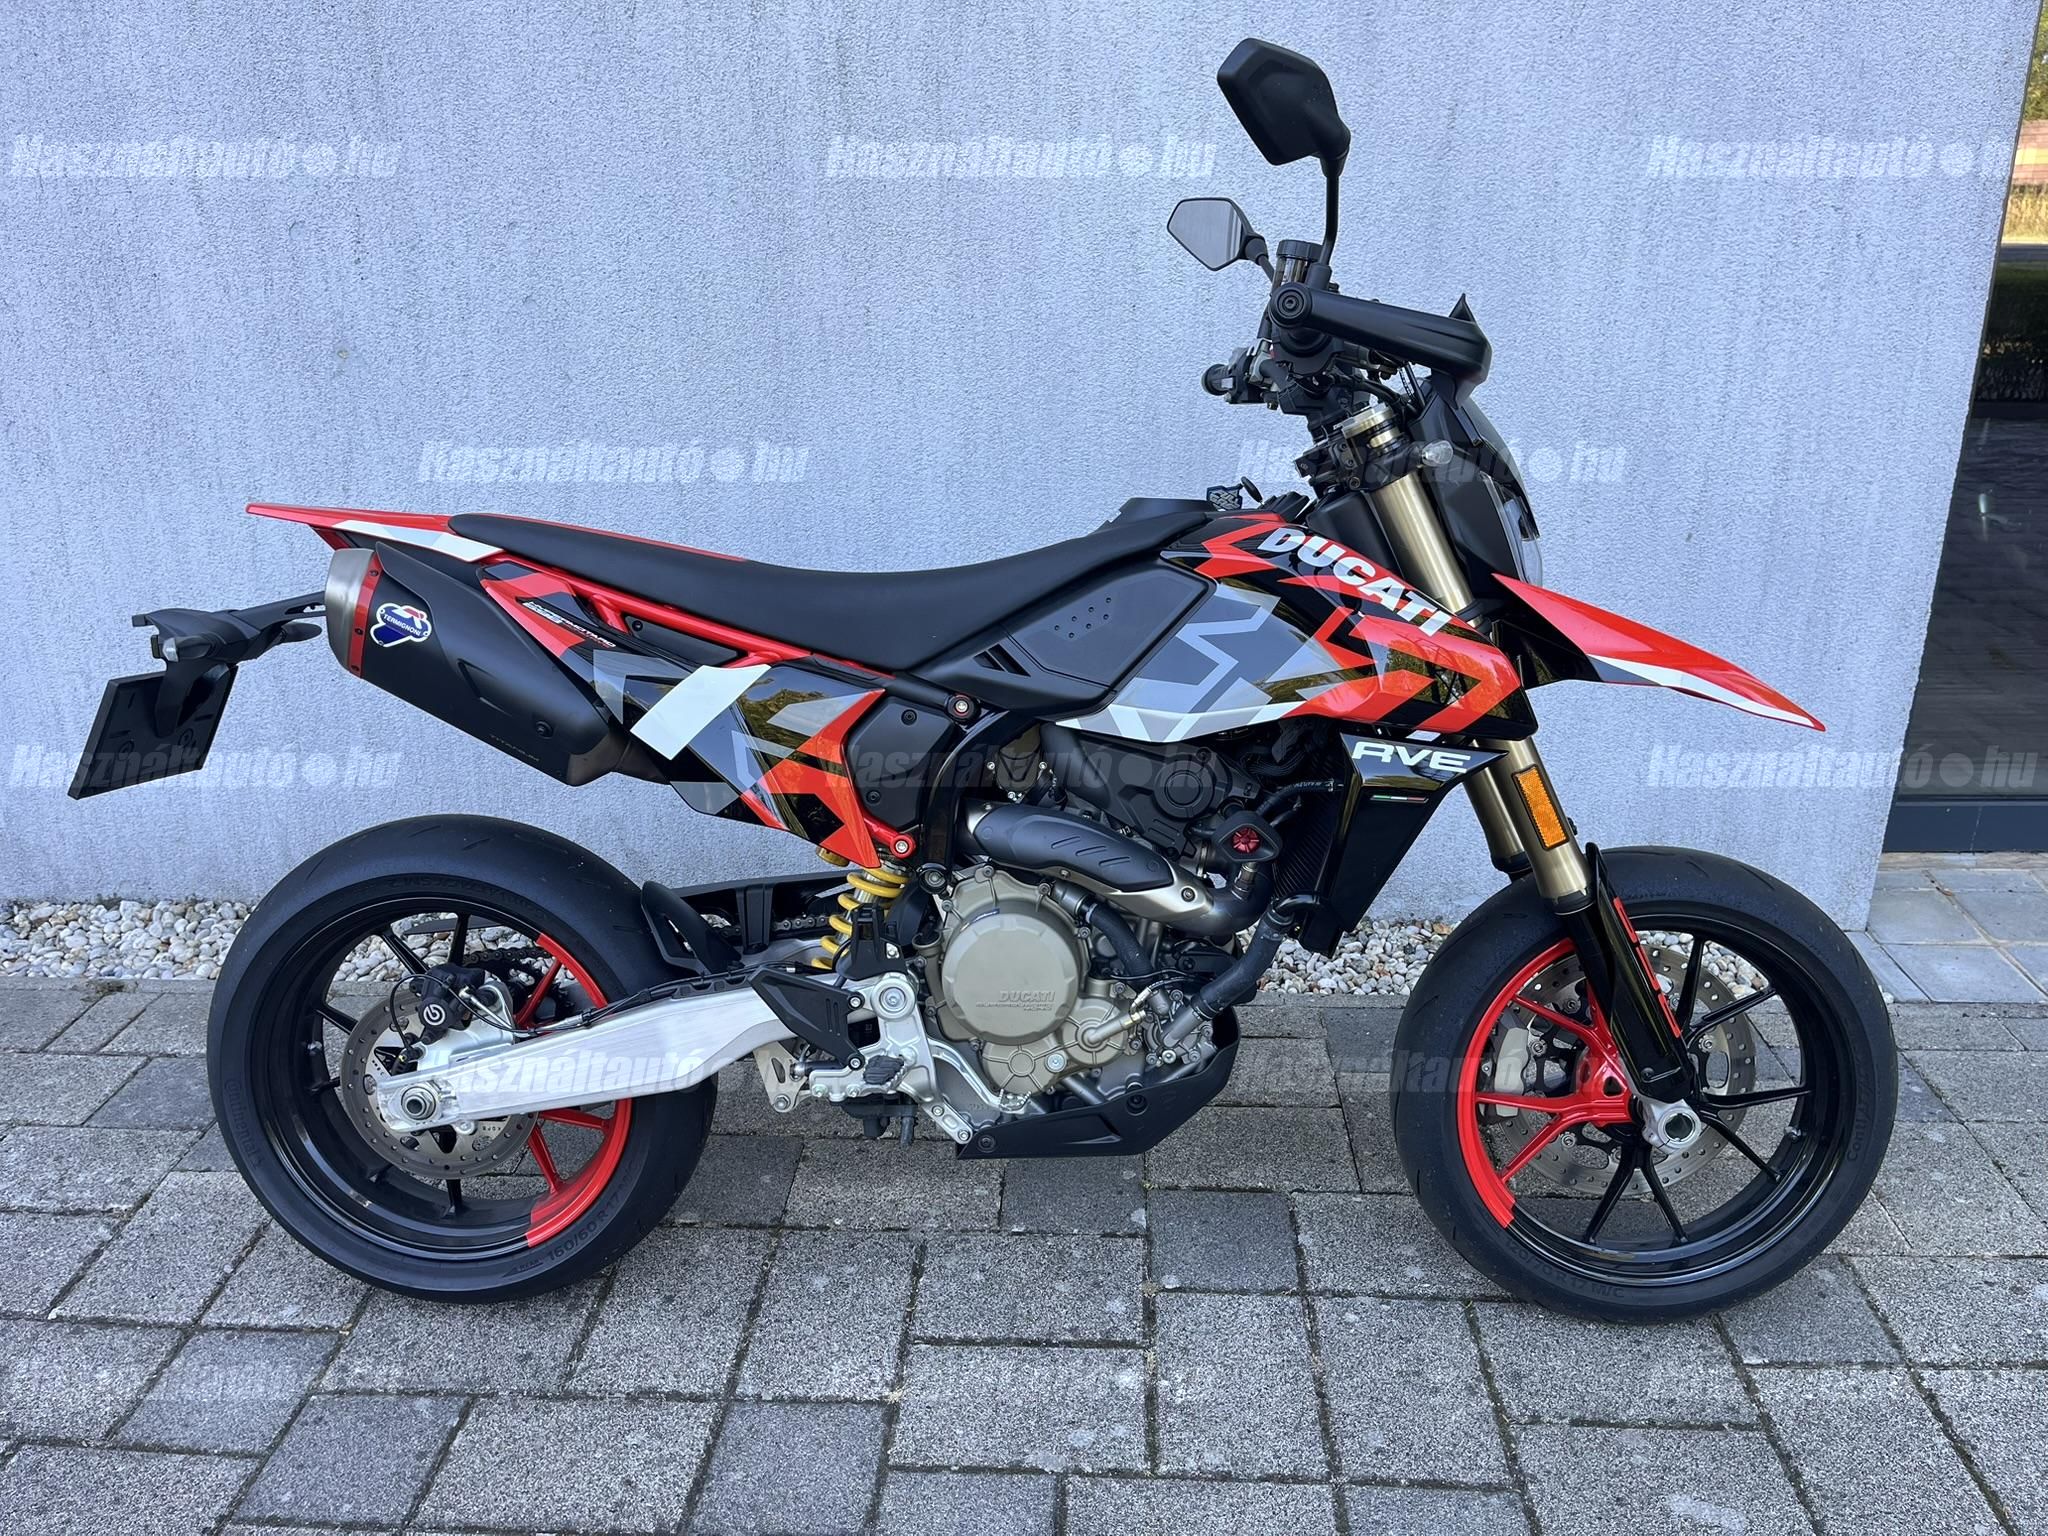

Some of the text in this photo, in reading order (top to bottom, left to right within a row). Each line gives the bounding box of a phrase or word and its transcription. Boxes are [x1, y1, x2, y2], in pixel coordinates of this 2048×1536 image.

[1257, 527, 1452, 637] DUCATI
[383, 613, 421, 637] TERMIGNONI
[1351, 741, 1471, 773] RVE
[999, 991, 1056, 1002] DUCATI
[546, 1222, 598, 1261] 160/60
[1504, 1238, 1553, 1276] 120/70
